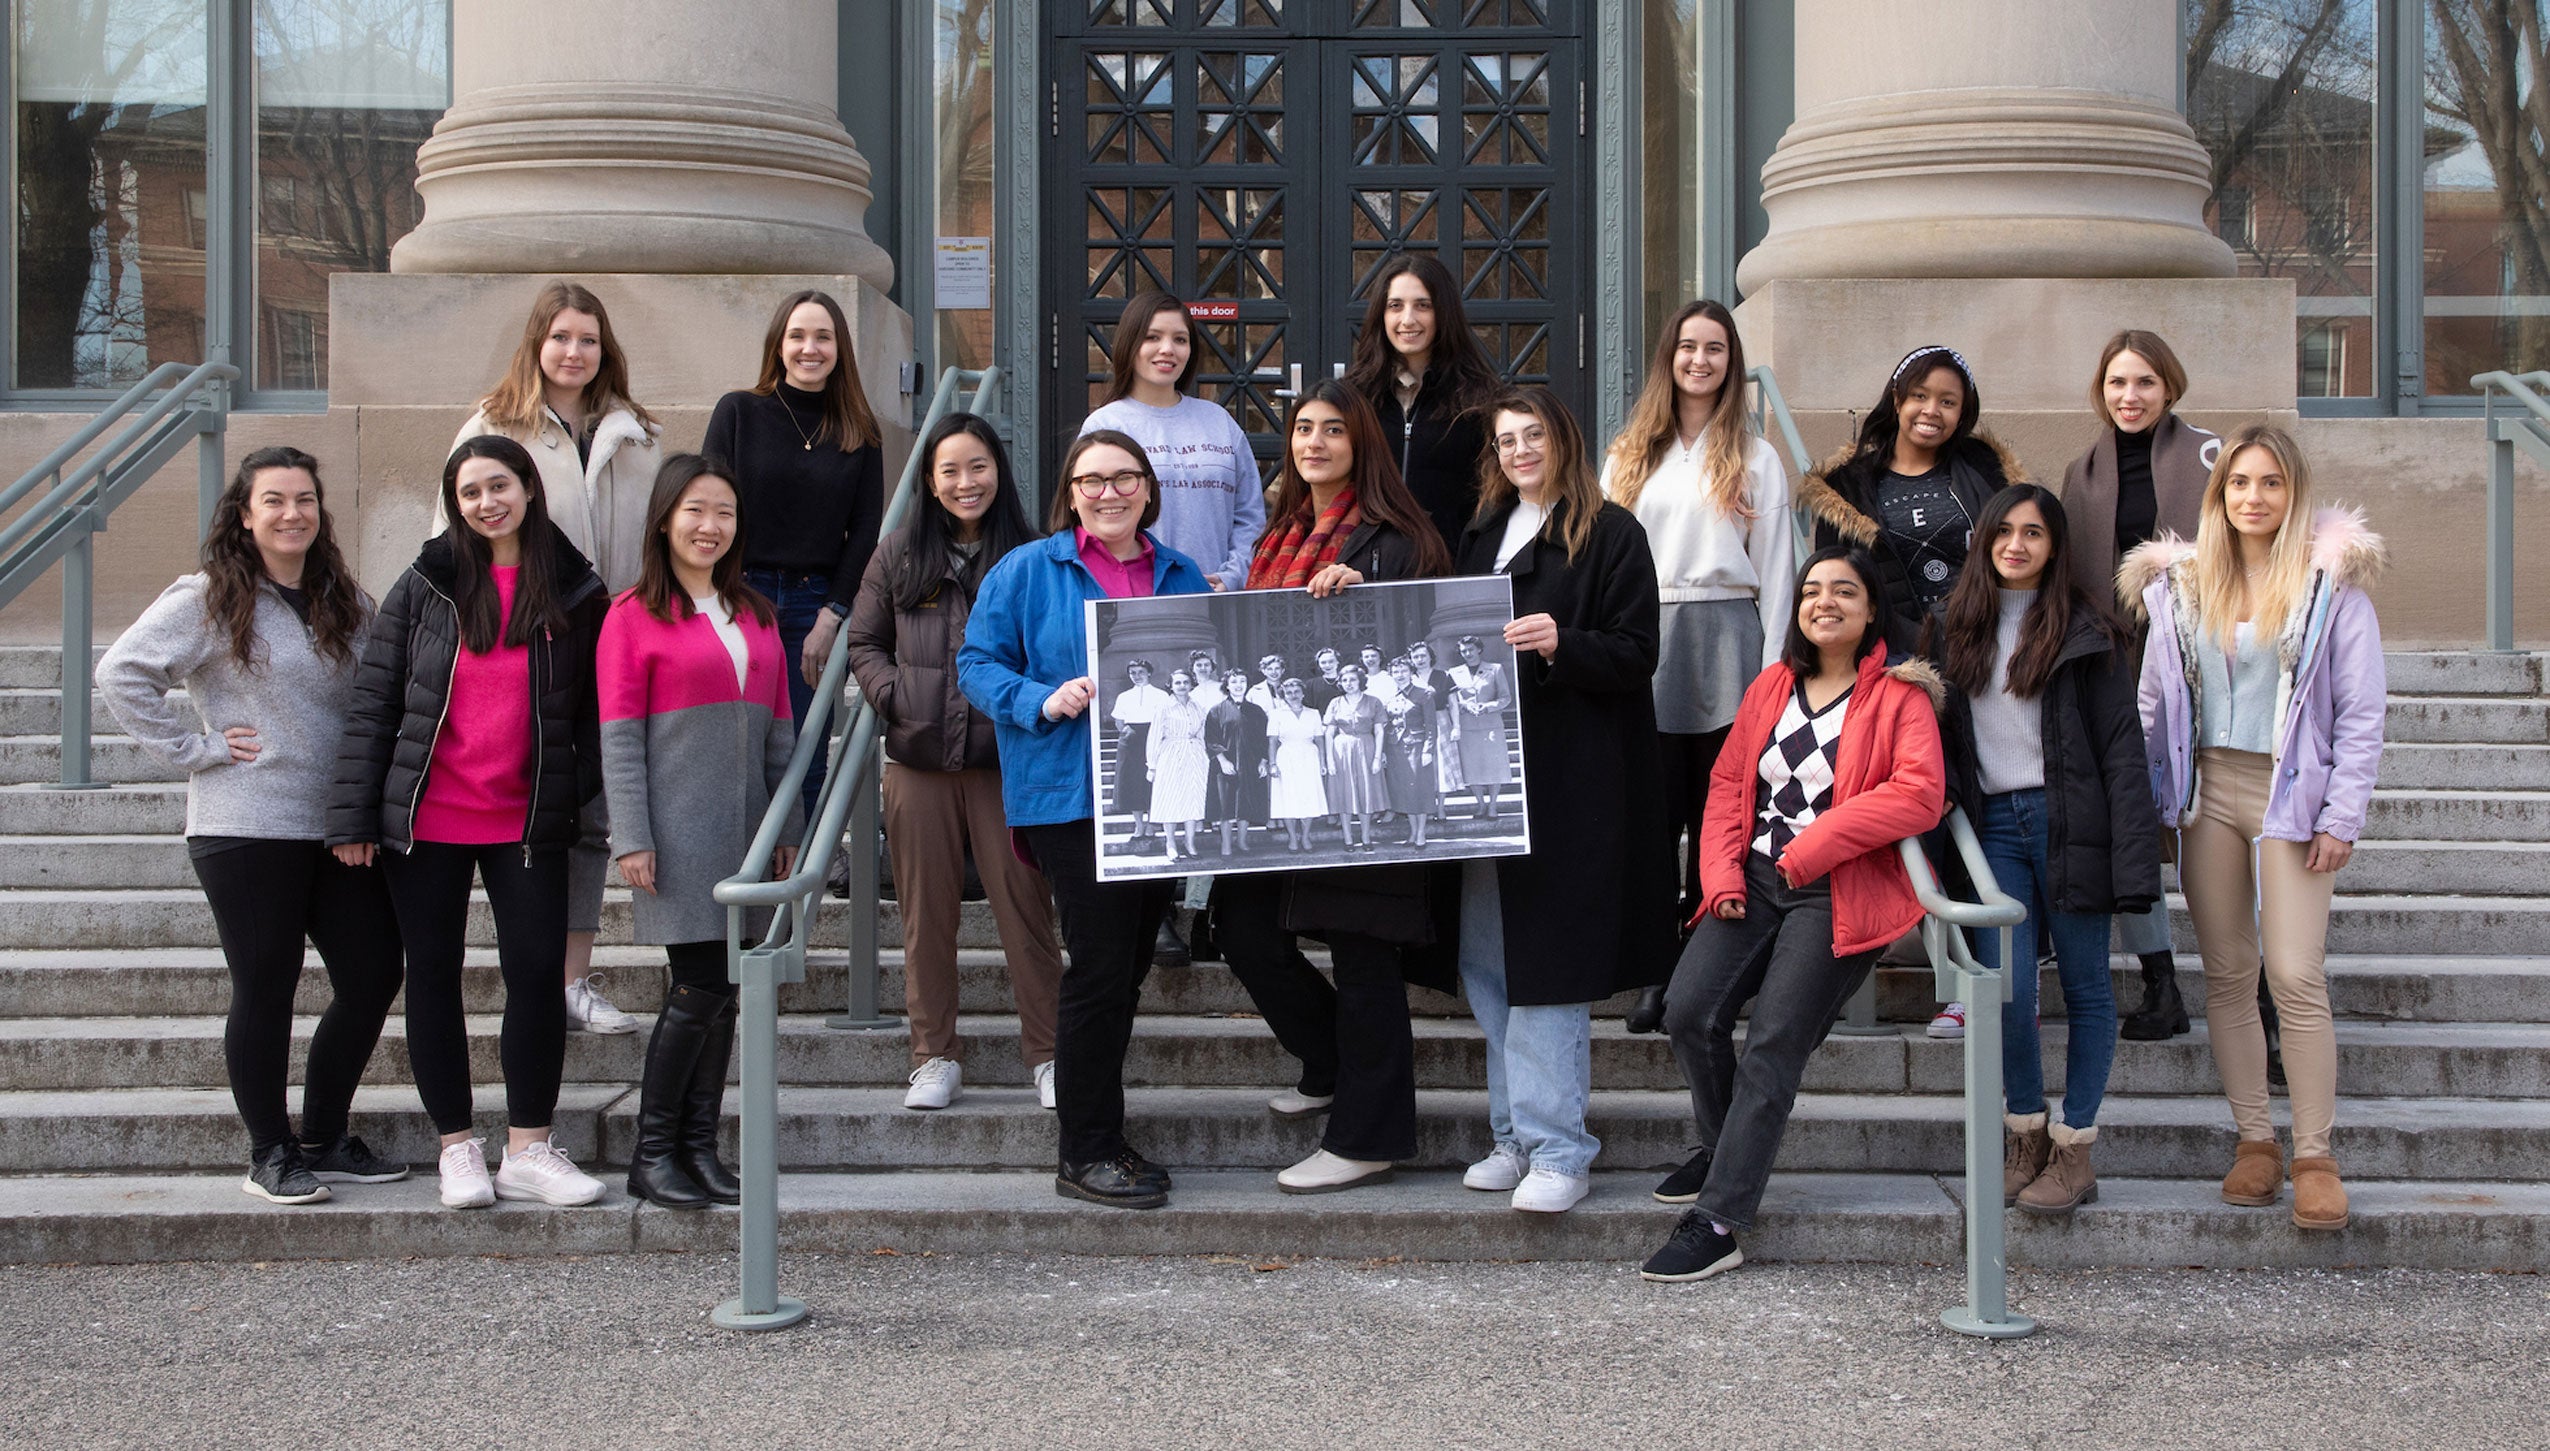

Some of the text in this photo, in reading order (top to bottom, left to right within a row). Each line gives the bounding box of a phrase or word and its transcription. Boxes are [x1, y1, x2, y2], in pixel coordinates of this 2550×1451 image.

[1189, 306, 1235, 316] this door
[1174, 444, 1196, 455] LAW
[1201, 443, 1236, 455] SCHOOL
[1884, 492, 1940, 506] ESCAPE
[1911, 508, 1927, 528] E
